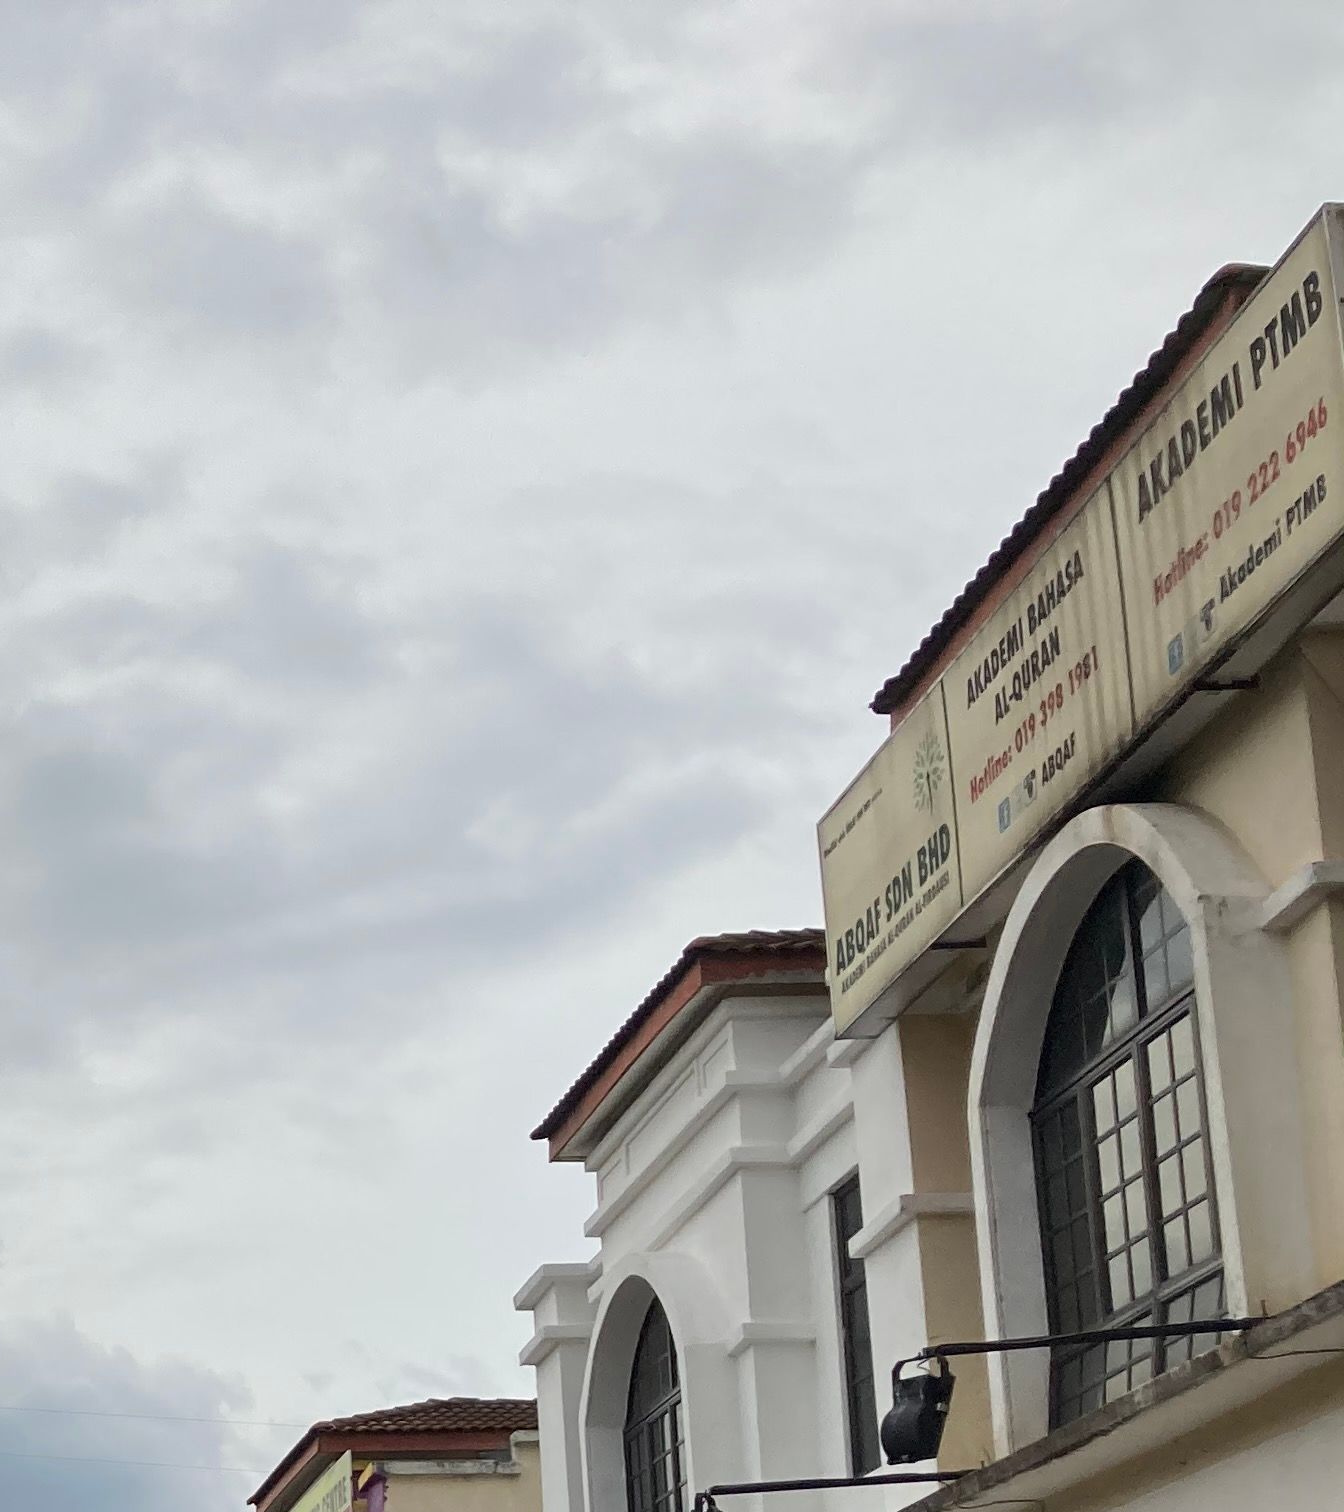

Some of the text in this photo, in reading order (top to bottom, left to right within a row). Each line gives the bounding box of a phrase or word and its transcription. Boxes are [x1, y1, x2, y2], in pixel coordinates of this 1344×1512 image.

[1138, 270, 1322, 524] AKADEMI PTMB
[1154, 396, 1328, 605] Hotline: 019 222 6946
[1220, 473, 1328, 604] Akademi PTMB
[967, 550, 1084, 710] AKADEMI BAHASA
[995, 626, 1061, 727] AL-QURAN
[970, 645, 1099, 805] Hotline: 019 398 1981
[1042, 731, 1076, 786] ABQAF
[836, 897, 881, 976] ABQAF
[885, 860, 913, 922] SDN
[917, 823, 951, 887] BHD
